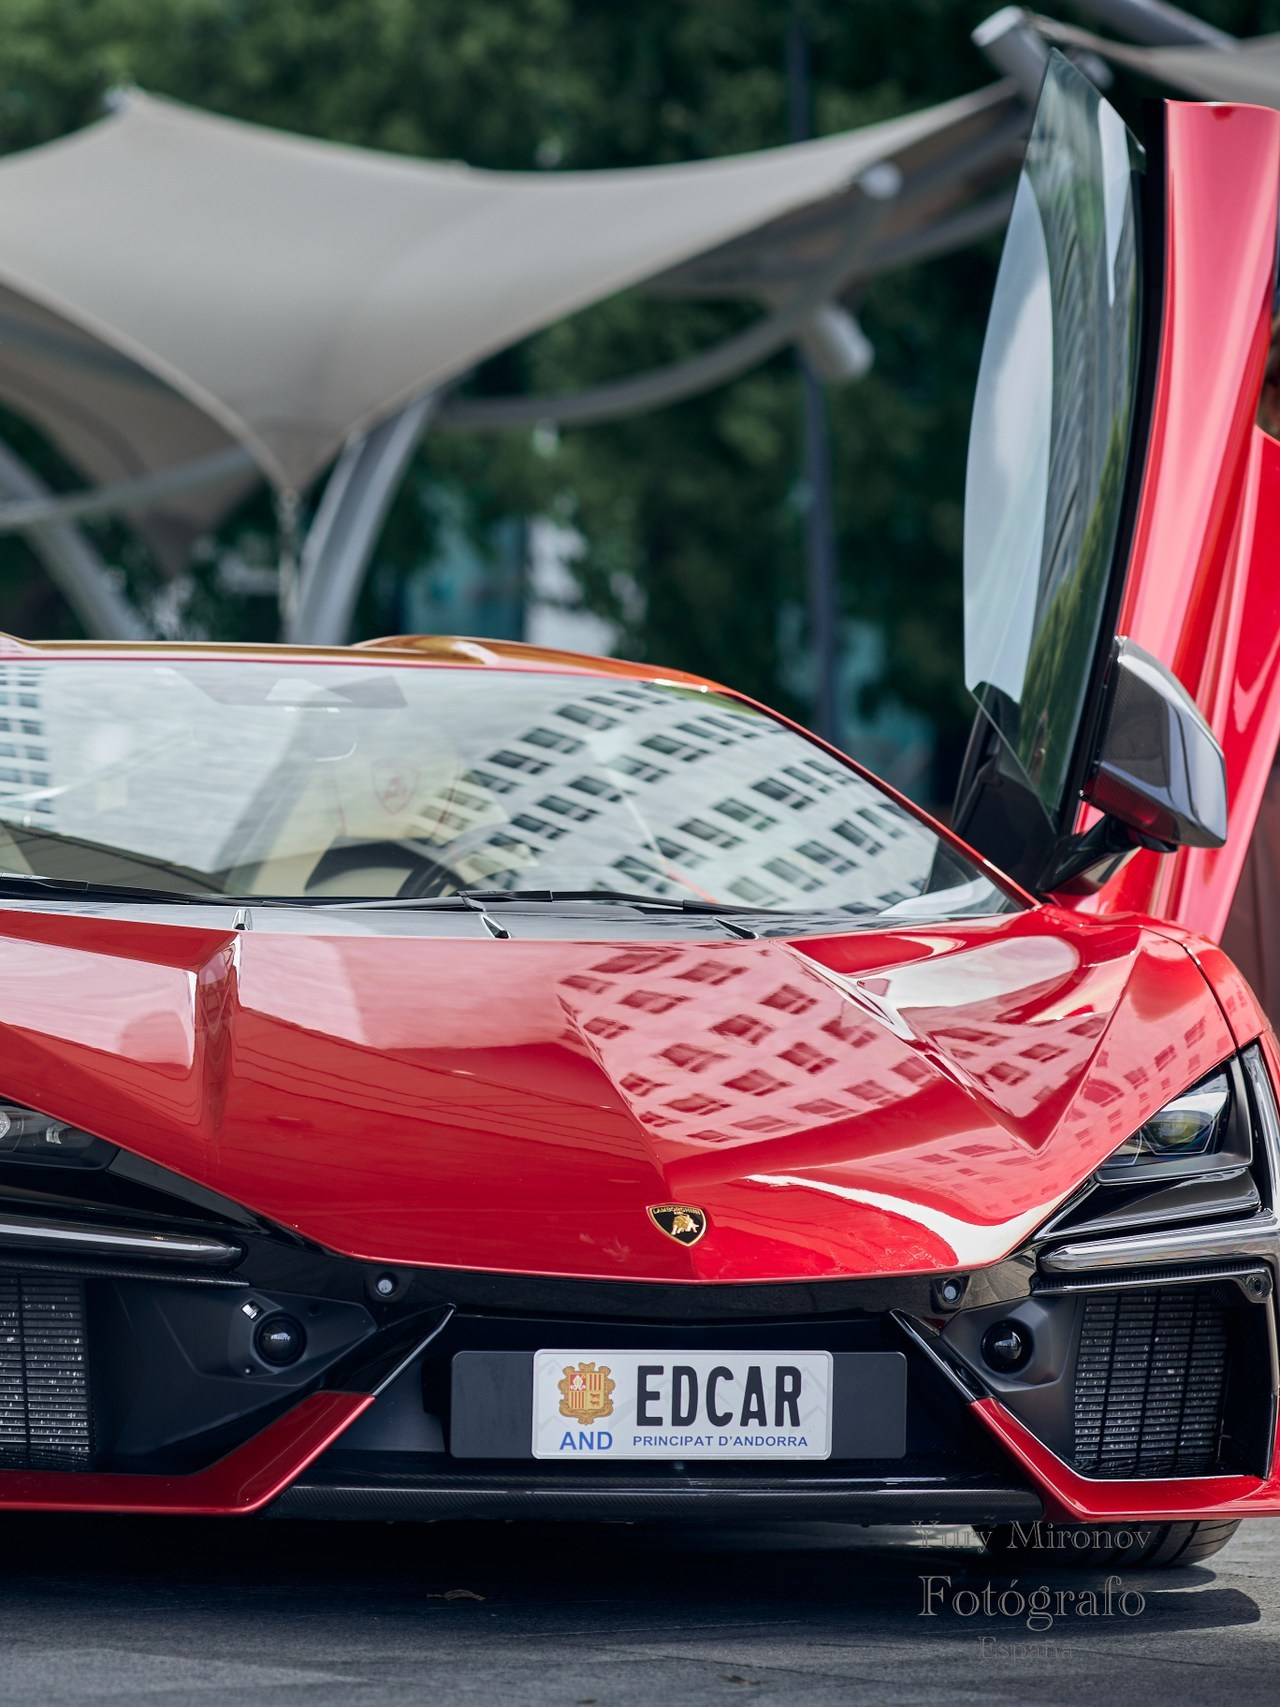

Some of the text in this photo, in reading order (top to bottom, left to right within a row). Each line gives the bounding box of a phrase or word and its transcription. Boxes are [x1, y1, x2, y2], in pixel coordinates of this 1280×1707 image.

[637, 1365, 802, 1427] EDCAR
[559, 1431, 613, 1450] AND
[633, 1435, 713, 1447] PRINCIPAT
